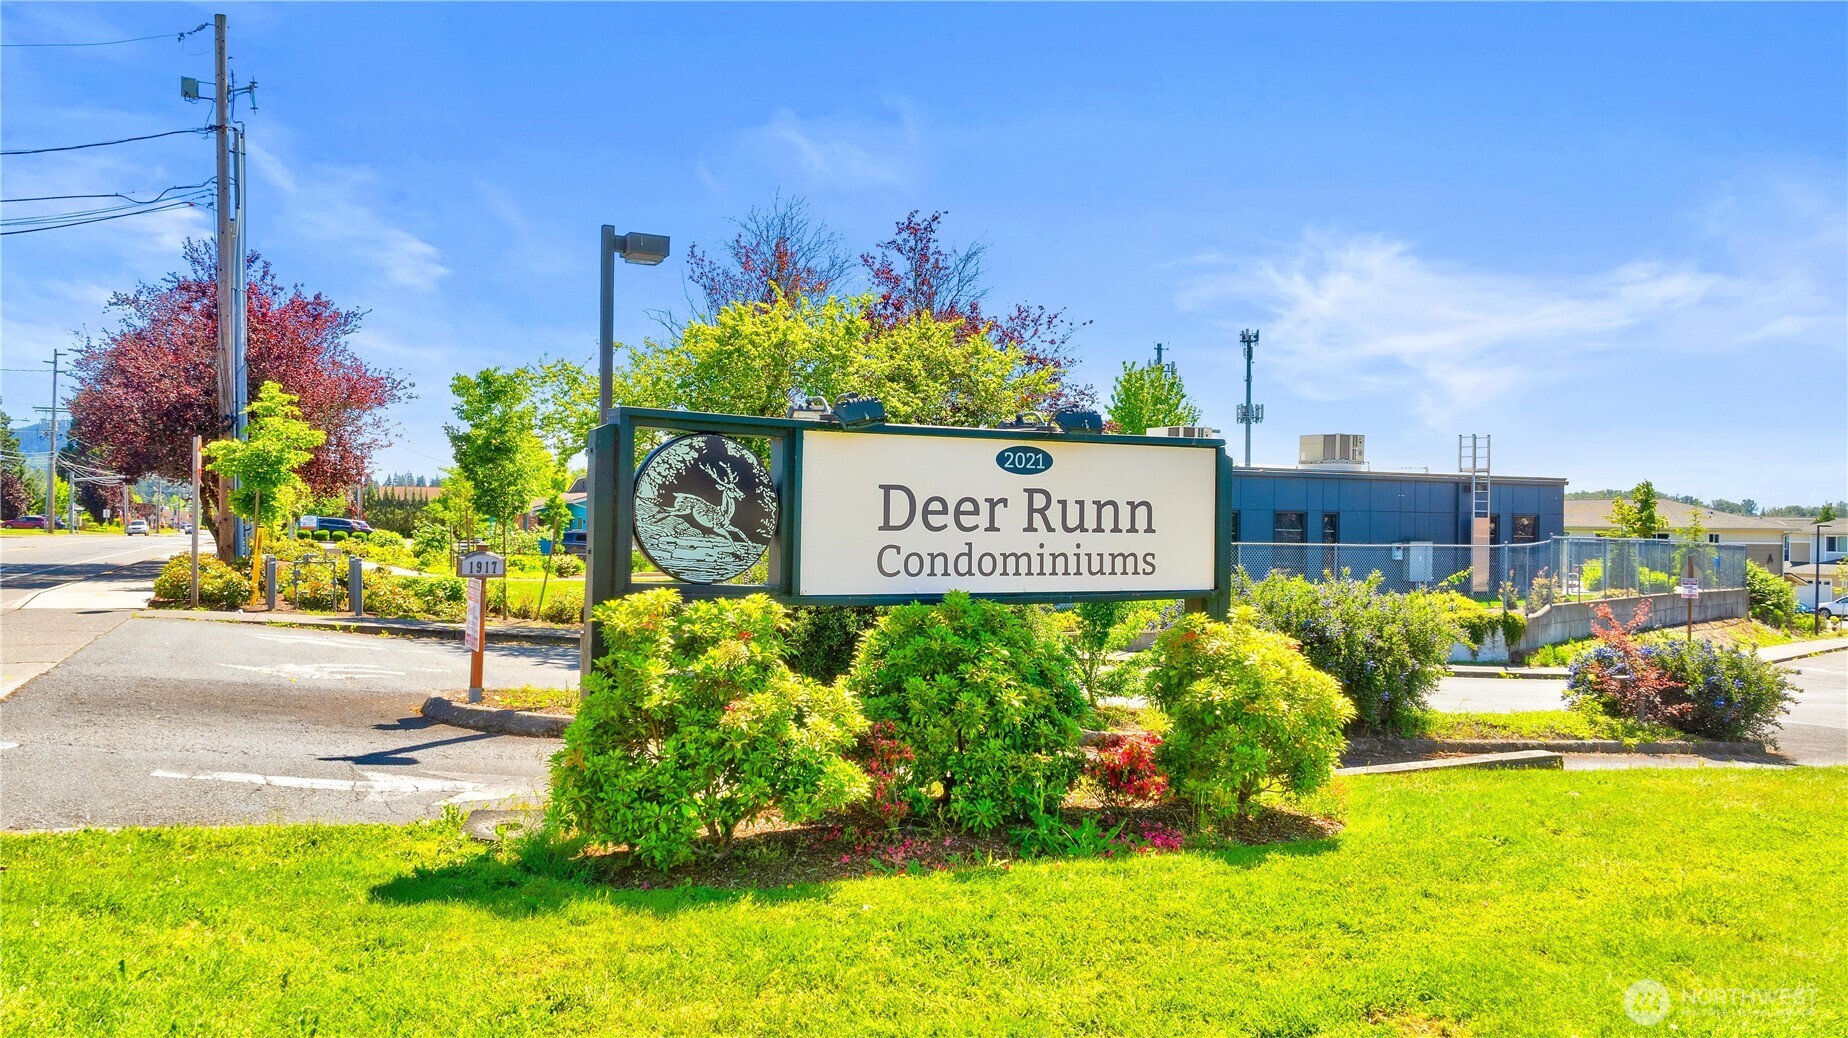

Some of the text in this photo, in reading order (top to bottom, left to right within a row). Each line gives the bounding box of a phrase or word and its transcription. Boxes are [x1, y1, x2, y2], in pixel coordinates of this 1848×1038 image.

[1004, 452, 1046, 469] 2021
[877, 484, 1157, 534] Deer Runn
[469, 561, 498, 574] 1917
[876, 542, 1157, 578] Condominiums
